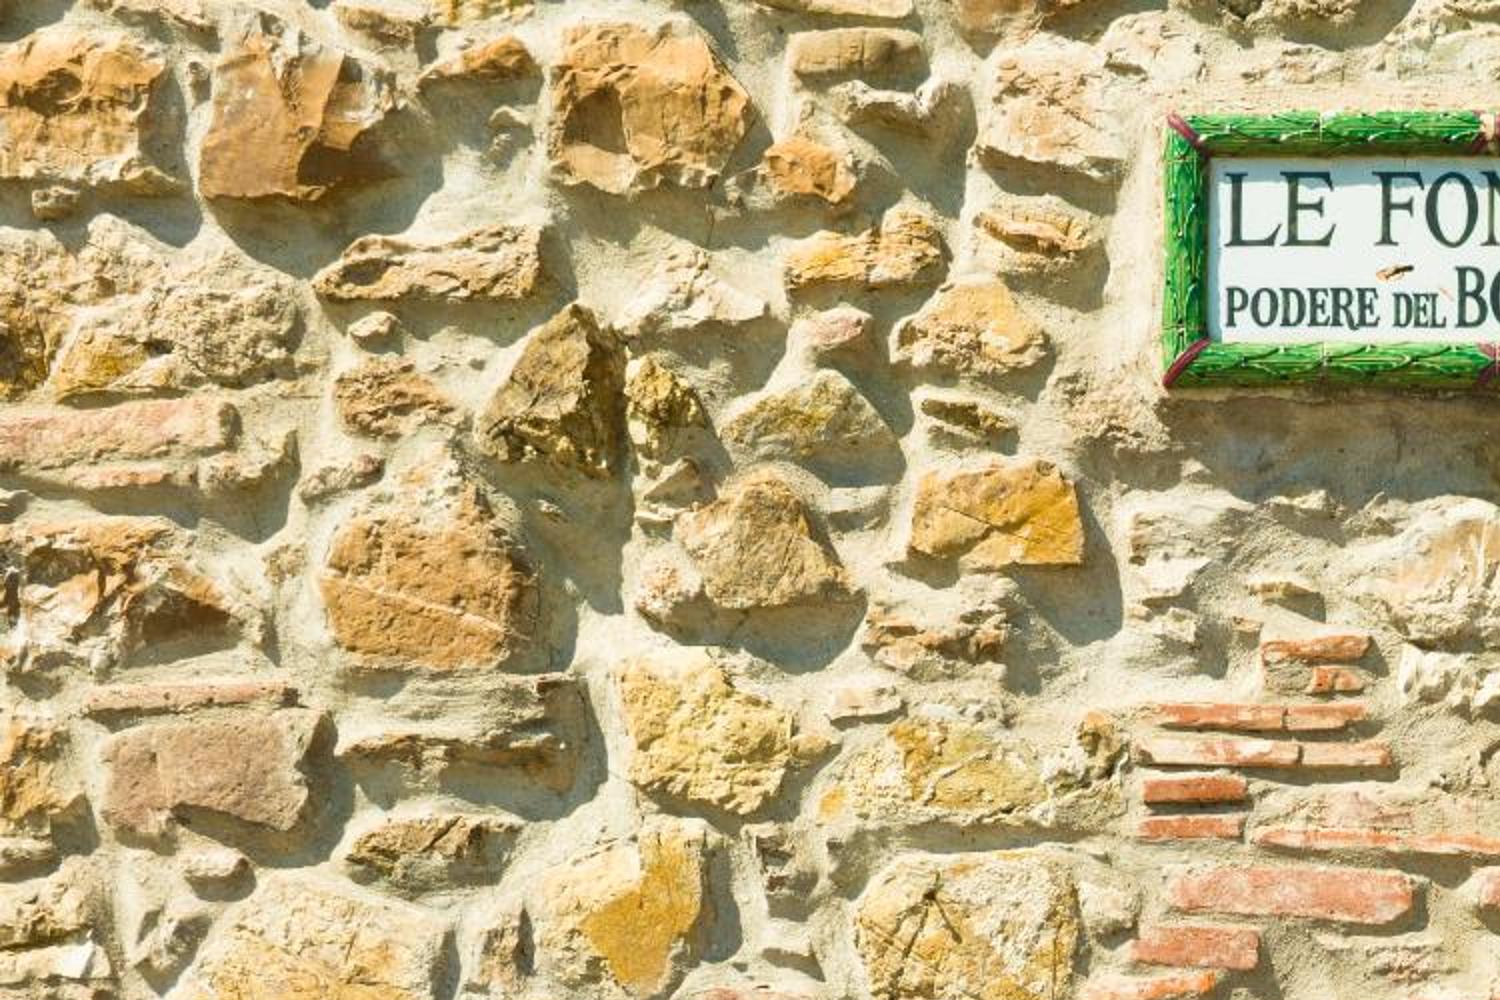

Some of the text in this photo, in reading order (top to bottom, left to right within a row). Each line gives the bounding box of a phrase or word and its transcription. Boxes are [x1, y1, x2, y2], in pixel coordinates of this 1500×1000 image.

[1223, 170, 1336, 248] LE
[1225, 286, 1381, 331] PODERE
[1392, 292, 1447, 330] DEL
